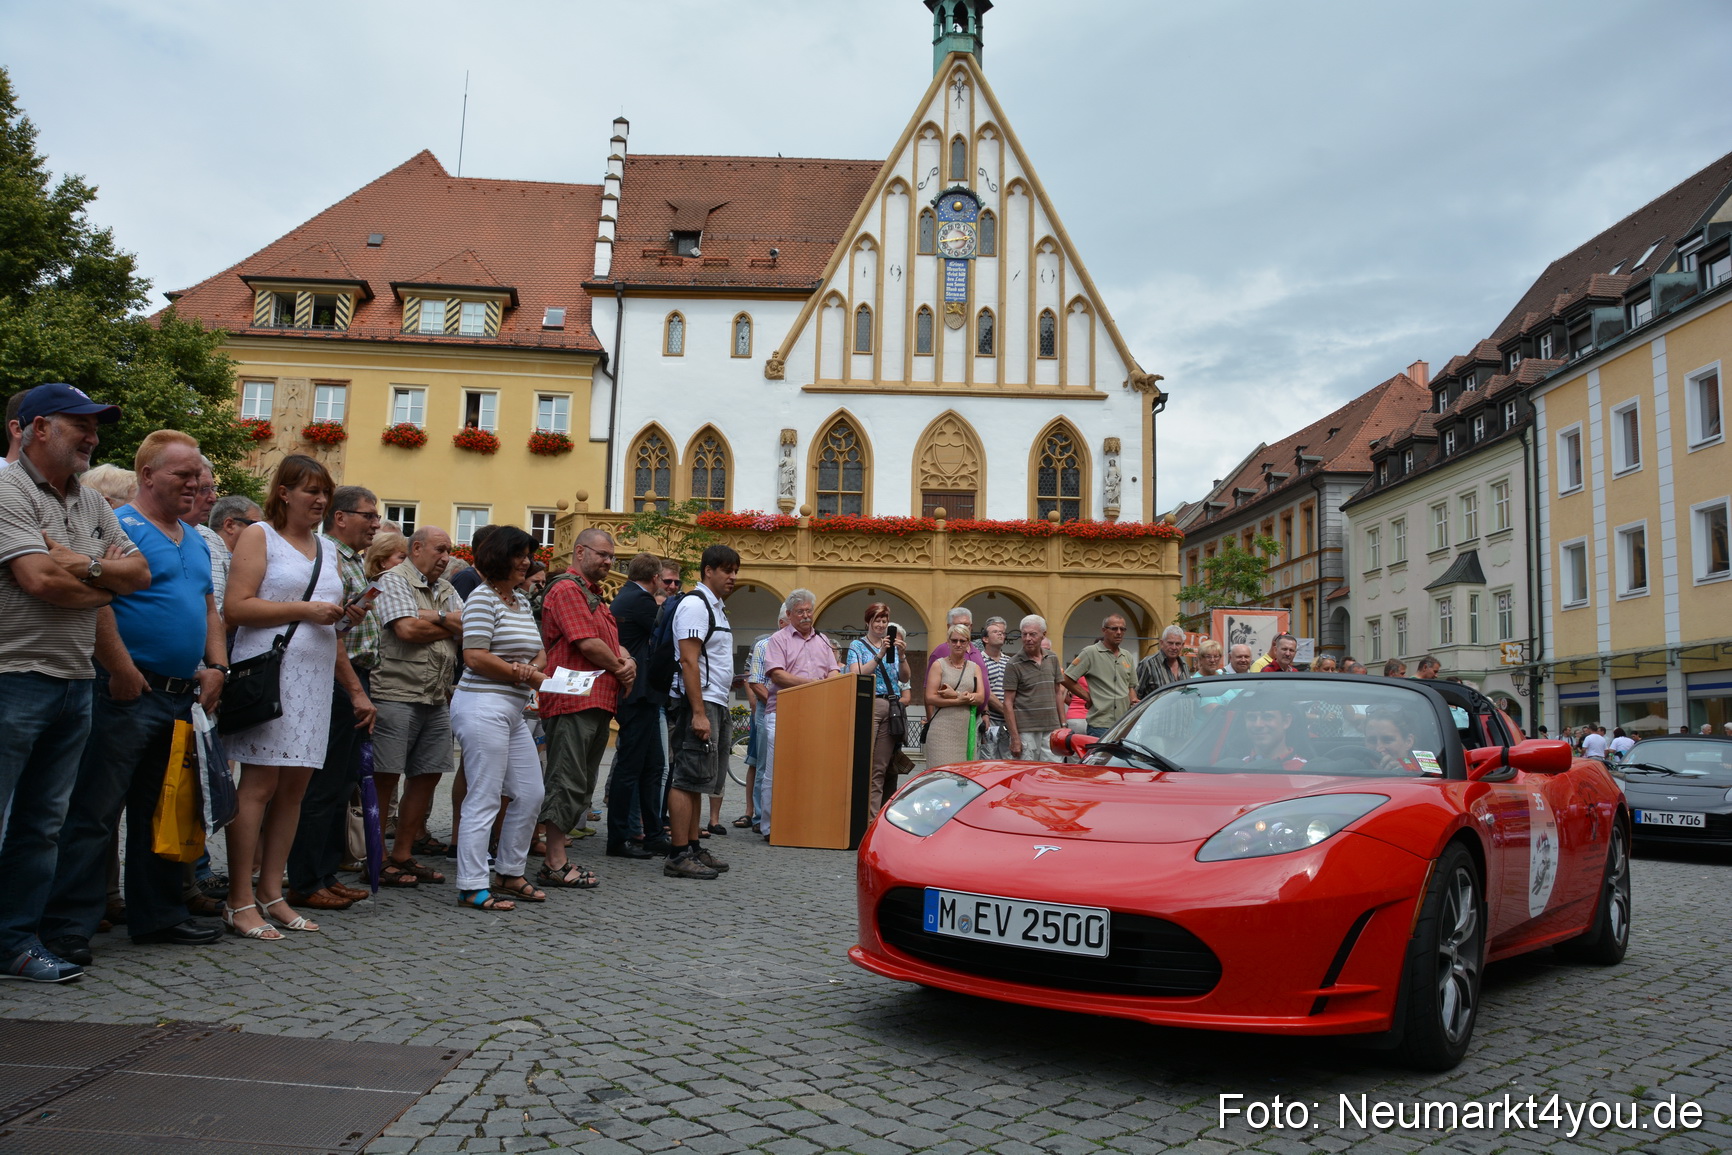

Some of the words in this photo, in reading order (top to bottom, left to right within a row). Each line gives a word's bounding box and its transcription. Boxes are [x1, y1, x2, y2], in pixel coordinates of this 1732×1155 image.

[1644, 809, 1652, 823] N
[1659, 813, 1674, 824] TR
[1678, 814, 1701, 826] 706
[928, 913, 934, 924] D
[939, 896, 956, 930] M
[974, 901, 1012, 937] EV
[1021, 907, 1104, 949] 2500
